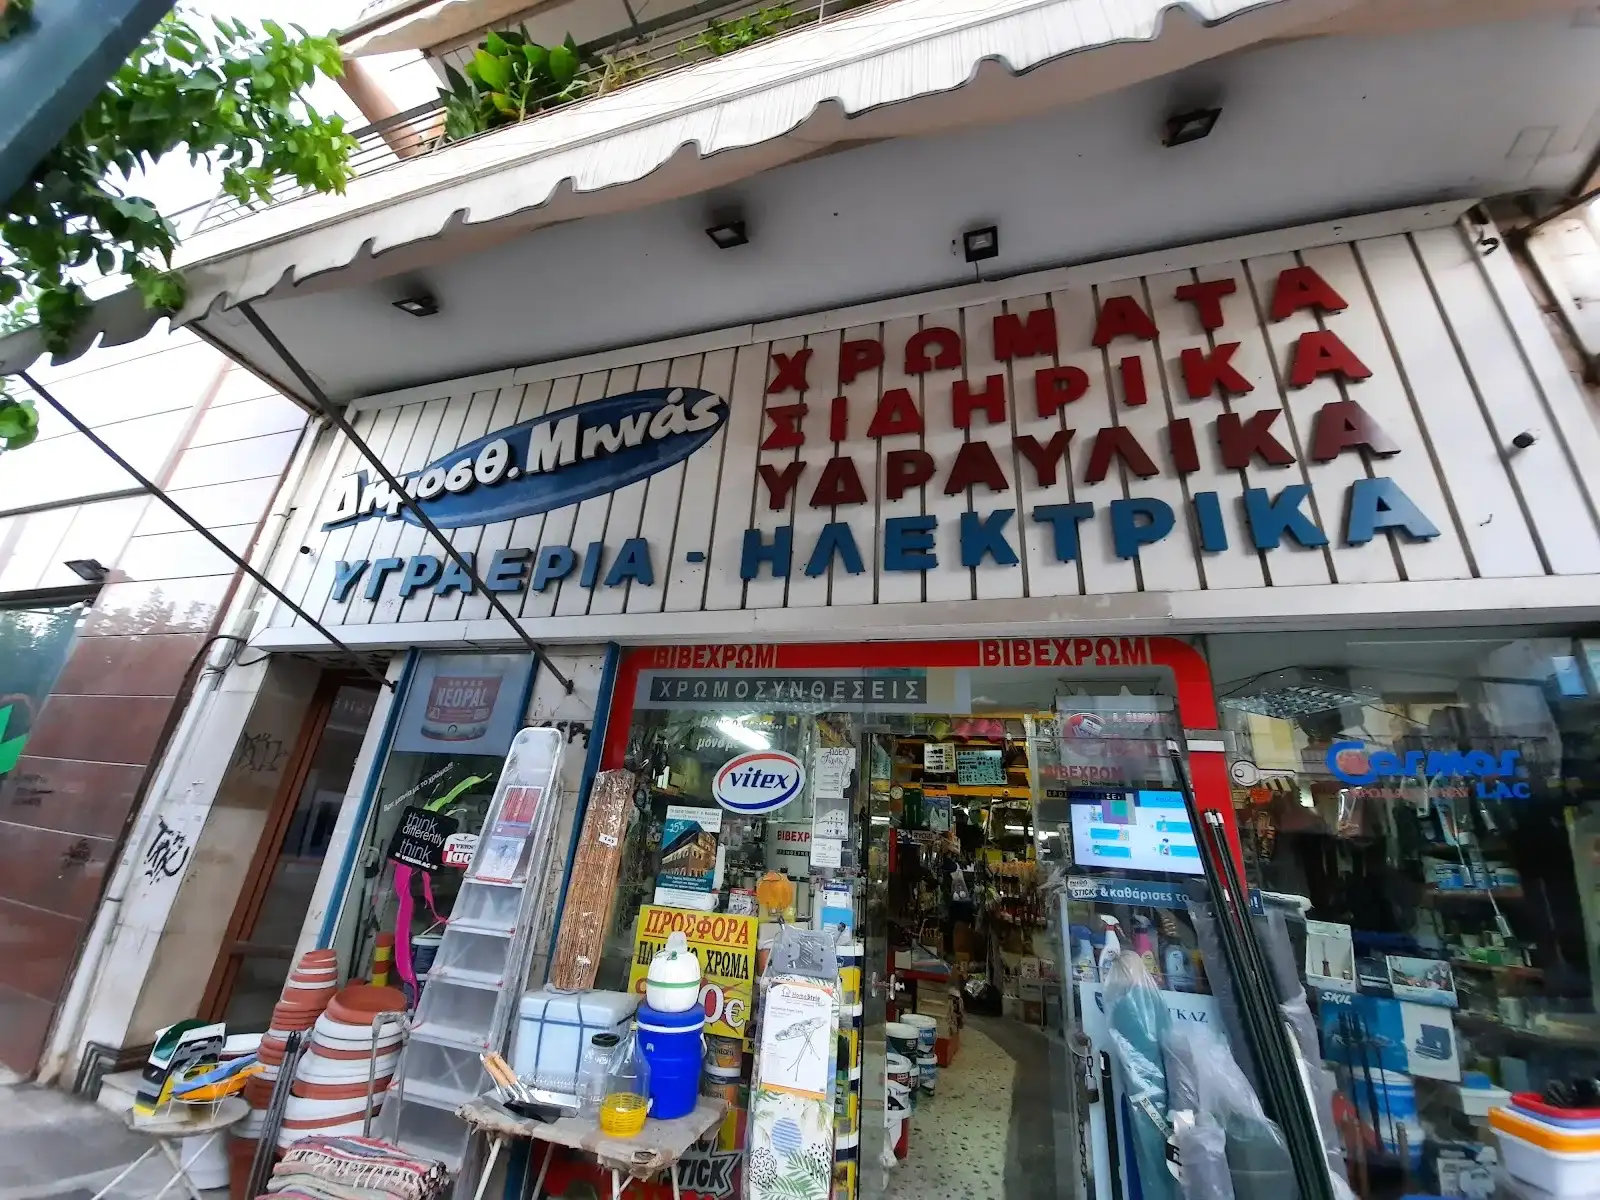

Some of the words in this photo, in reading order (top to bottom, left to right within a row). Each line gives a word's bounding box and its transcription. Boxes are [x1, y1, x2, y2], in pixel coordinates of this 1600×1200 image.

[767, 265, 1348, 394] ΧΡΩΜΑΤΑ
[760, 329, 1373, 450] ΣΙΔΗΡΙΚΑ
[526, 388, 728, 474] Μηνάς
[757, 400, 1402, 511] ΥΔΡΑΥΛΙΚΑ
[332, 537, 654, 601] ΥΓΡΑΕΡΙΑ
[740, 477, 1441, 580] ΗΛΕΚΤΡΙΚΑ
[655, 644, 776, 668] ΒΙΒΕΧΡΩΜ
[982, 638, 1150, 667] ΒΙΒΕΧΡΩΜ
[436, 687, 489, 708] NEOPAL
[658, 679, 920, 700] ΧΡΩΜΟΣΥΝΘΕΣΕΙΣ
[730, 766, 790, 790] vitex
[1476, 780, 1532, 800] LAC
[407, 811, 439, 834] think
[402, 824, 446, 848] differently
[777, 829, 812, 843] ΒΙΒΕΧΡ
[400, 838, 432, 862] think
[1074, 888, 1095, 897] STICK
[644, 909, 749, 945] ΠΡΟΣΦΟΡΑ
[703, 949, 749, 980] ΧΡΩΜΑ
[698, 982, 745, 1027] 0€
[1322, 991, 1352, 1005] SKIL
[668, 1158, 728, 1190] TICK
